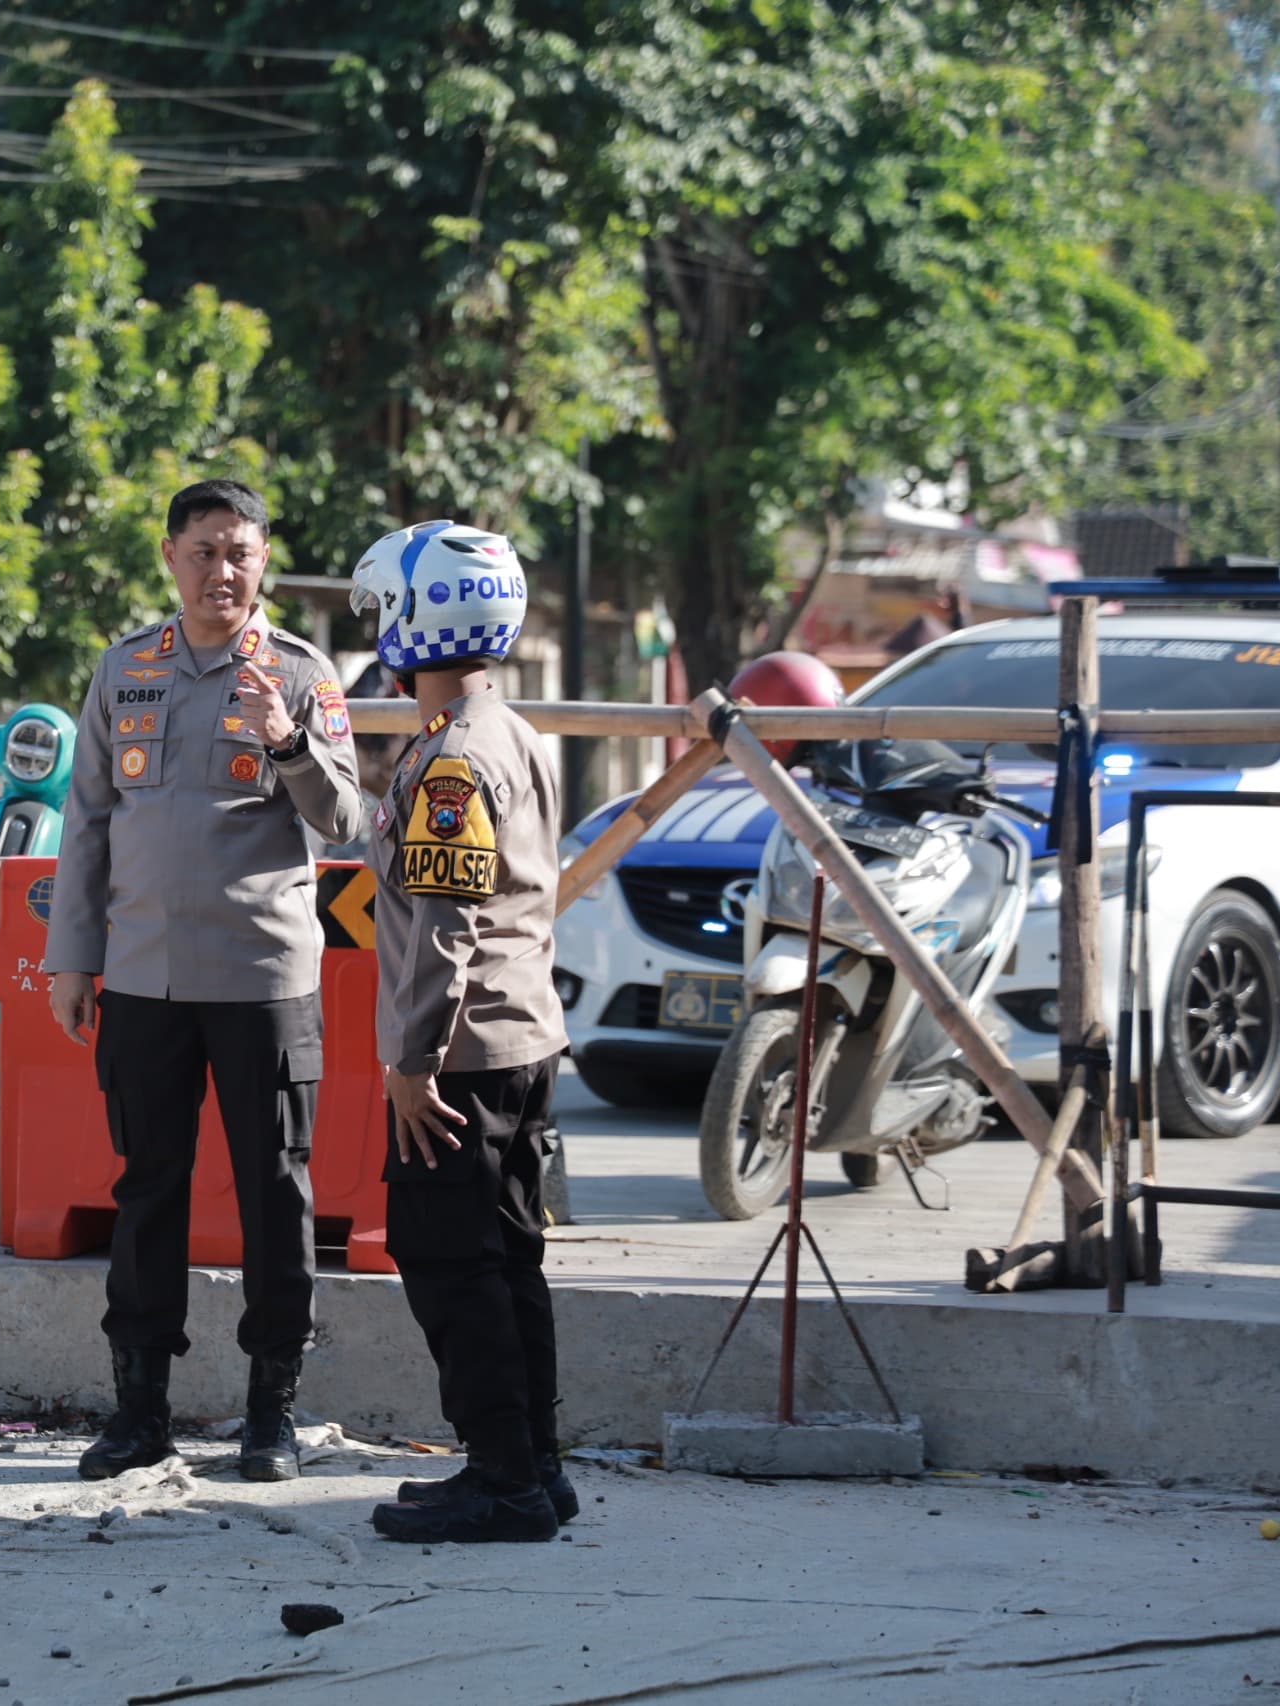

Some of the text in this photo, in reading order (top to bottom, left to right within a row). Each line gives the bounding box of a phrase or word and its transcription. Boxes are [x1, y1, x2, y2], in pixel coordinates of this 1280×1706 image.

[458, 576, 525, 602] POLIS
[117, 689, 166, 704] BOBBY
[17, 957, 46, 973] P-A
